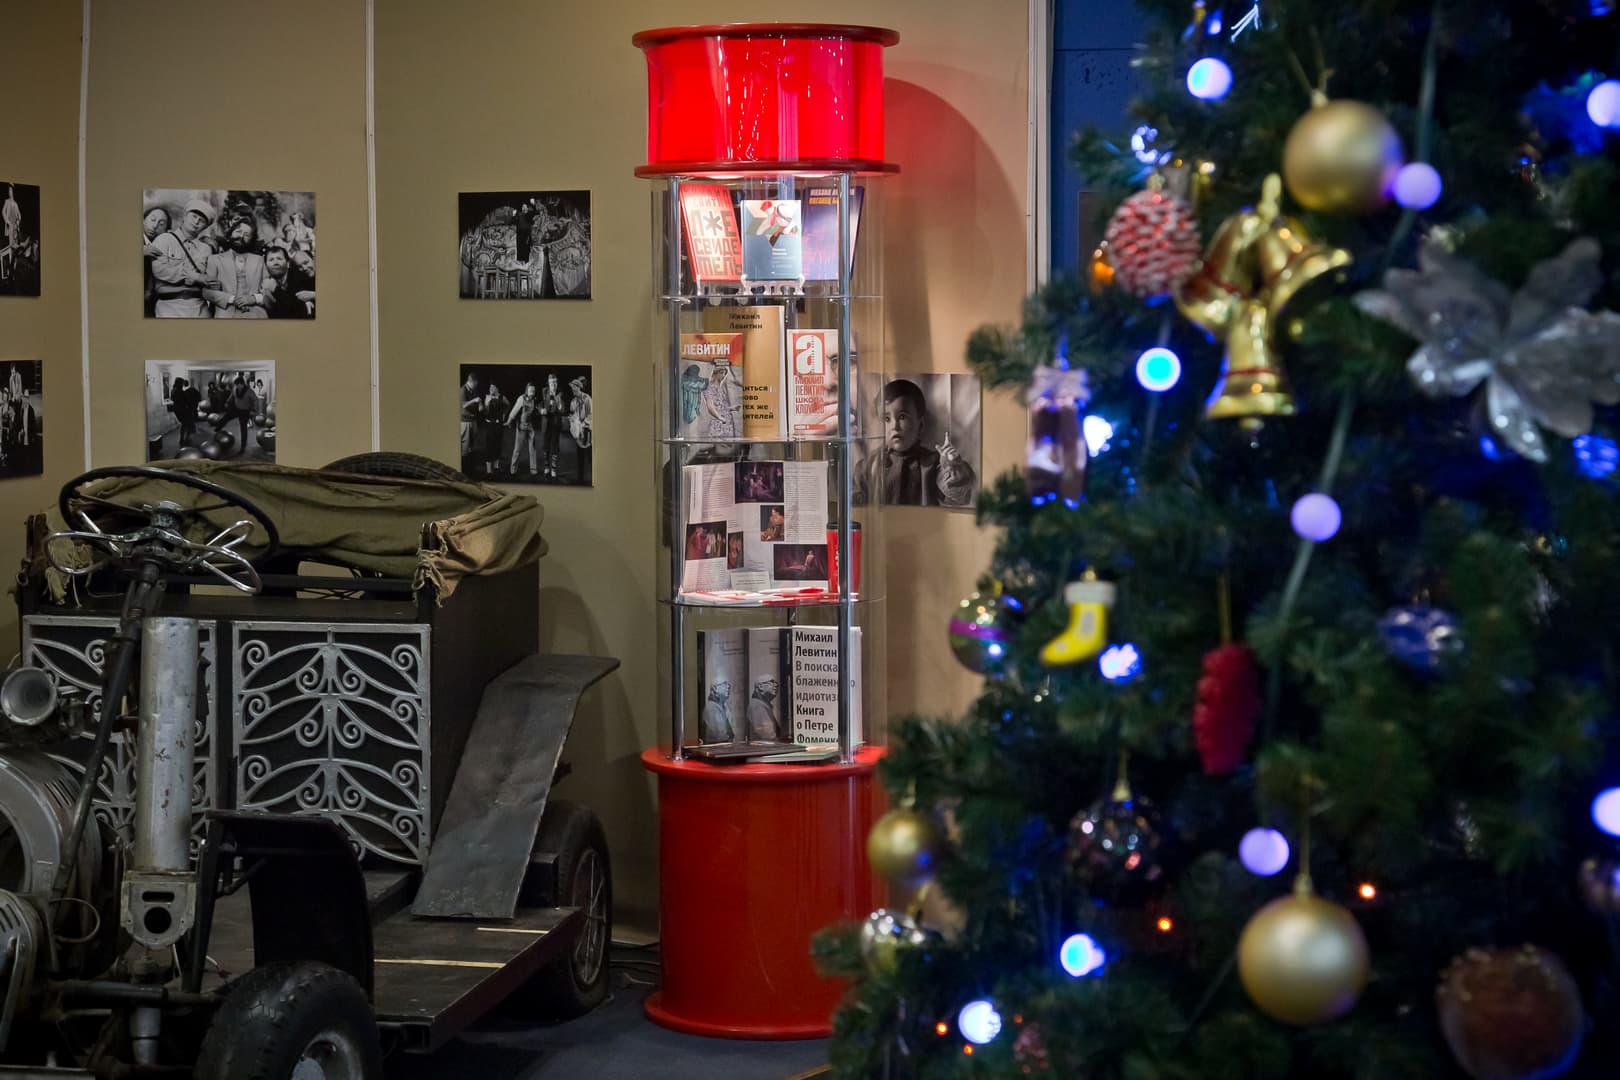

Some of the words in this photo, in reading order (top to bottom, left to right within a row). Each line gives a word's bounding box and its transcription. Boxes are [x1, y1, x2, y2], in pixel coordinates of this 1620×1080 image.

[682, 343, 730, 355] ЛЕВИТИН
[743, 385, 768, 393] иться
[743, 411, 774, 420] ителей
[795, 631, 833, 643] Михаил
[795, 646, 837, 658] Левитин
[796, 660, 802, 671] В
[804, 663, 839, 672] поиска
[796, 692, 838, 702] идиотиз
[796, 704, 825, 716] Книга
[796, 722, 802, 730] о
[805, 719, 834, 733] Петре
